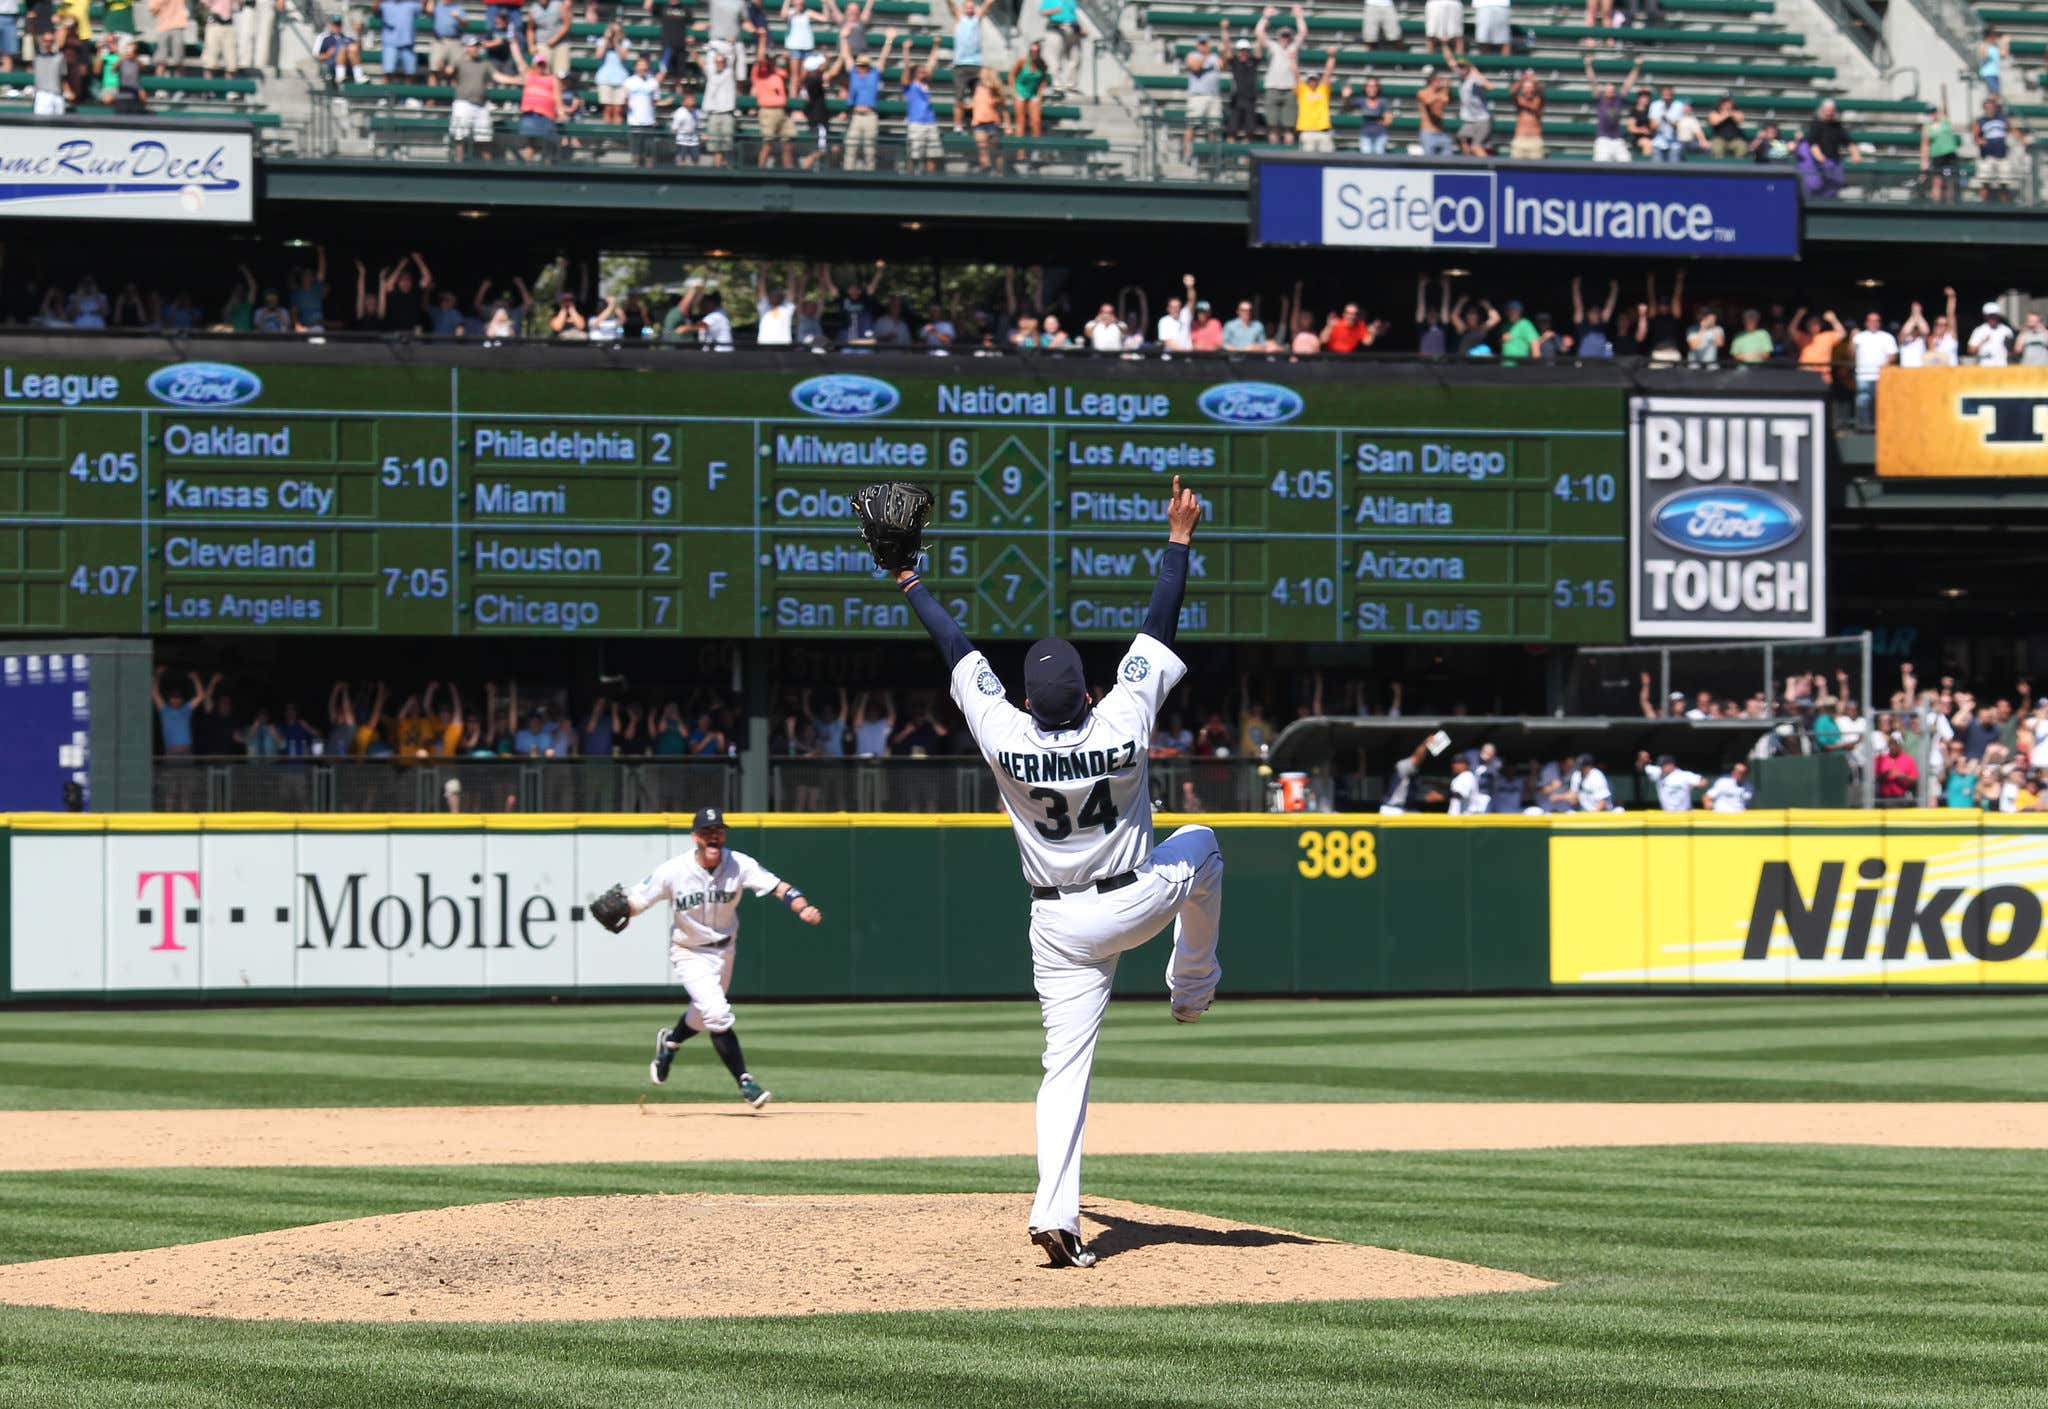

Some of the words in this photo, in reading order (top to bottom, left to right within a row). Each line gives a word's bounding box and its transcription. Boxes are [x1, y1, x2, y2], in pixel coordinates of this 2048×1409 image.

[1337, 183, 1485, 234] Safeco
[1503, 185, 1713, 241] Insurance
[4, 368, 118, 405] League
[938, 385, 1056, 415] National
[1065, 388, 1169, 419] League
[164, 425, 289, 456] Oakland
[476, 430, 635, 461] Philadelphia
[652, 433, 671, 462] 2
[777, 435, 927, 466] Milwaukee
[949, 438, 968, 466] 6
[1646, 418, 1808, 480] BUILT
[70, 453, 138, 483] 4:05
[382, 457, 448, 487] 5:10
[1070, 442, 1113, 465] Los
[1119, 442, 1215, 472] Angeles
[1357, 444, 1413, 472] San
[1422, 444, 1504, 479] Diego
[709, 462, 727, 490] F
[1003, 466, 1021, 495] 9
[1271, 469, 1333, 500] 4:05
[1555, 474, 1615, 502] 4:10
[166, 480, 268, 508] Kansas
[278, 481, 333, 512] City
[476, 484, 565, 513] Miami
[652, 486, 671, 515] 9
[950, 490, 967, 519] 5
[1070, 491, 1213, 522] Pittsbuh
[1356, 496, 1452, 525] Atlanta
[165, 537, 315, 568] Cleveland
[476, 542, 600, 571] Houston
[652, 543, 671, 572] 2
[774, 543, 929, 579] Washinn
[950, 546, 967, 575] 5
[1071, 548, 1136, 576] New
[1142, 548, 1206, 577] Yk
[1356, 551, 1464, 579] Arizona
[70, 566, 137, 595] 4:07
[383, 568, 448, 598] 7:05
[709, 572, 728, 599] F
[1003, 574, 1020, 601] 7
[1271, 576, 1333, 606] 4:10
[1554, 580, 1614, 608] 5:15
[1645, 560, 1807, 611] TOUGH
[165, 595, 211, 618] Los
[219, 594, 321, 621] Angeles
[475, 595, 599, 630] Chicago
[653, 596, 671, 624] 7
[778, 598, 834, 626] San
[844, 598, 908, 627] Fran
[949, 598, 969, 628] 2
[1070, 599, 1208, 630] Cinciati
[1358, 602, 1391, 631] St.
[1407, 604, 1480, 631] Louis
[1000, 740, 1136, 783] HERNANDEZ
[1028, 777, 1119, 841] 34
[1297, 830, 1378, 879] 388
[296, 873, 557, 950] Mobile
